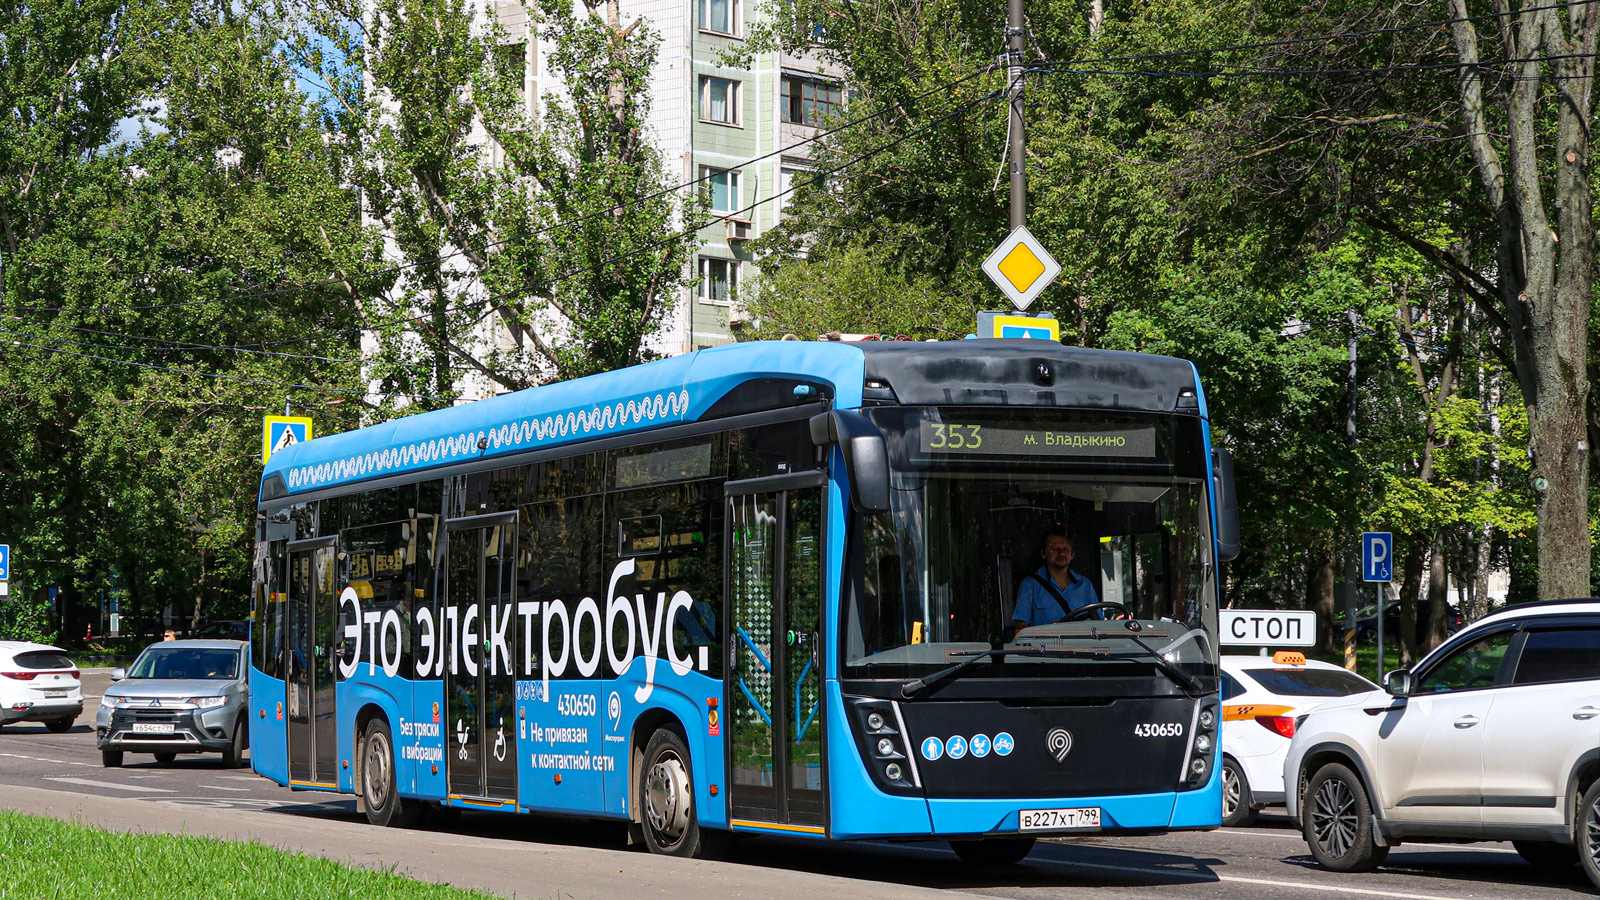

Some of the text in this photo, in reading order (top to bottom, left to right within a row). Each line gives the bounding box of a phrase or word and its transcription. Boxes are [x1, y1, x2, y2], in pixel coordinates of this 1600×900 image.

[930, 423, 983, 449] 353
[1024, 431, 1126, 448] м. Владыкино
[338, 557, 709, 704] Это электробус.
[1231, 616, 1301, 640] СТОП
[557, 693, 597, 717] 430650
[399, 717, 440, 741] Без тряски
[530, 722, 588, 747] Не привязан
[1134, 722, 1183, 737] 430650
[406, 741, 443, 765] вибраций
[531, 750, 615, 772] к контактной сети
[1024, 809, 1097, 828] В227ХТ 799
